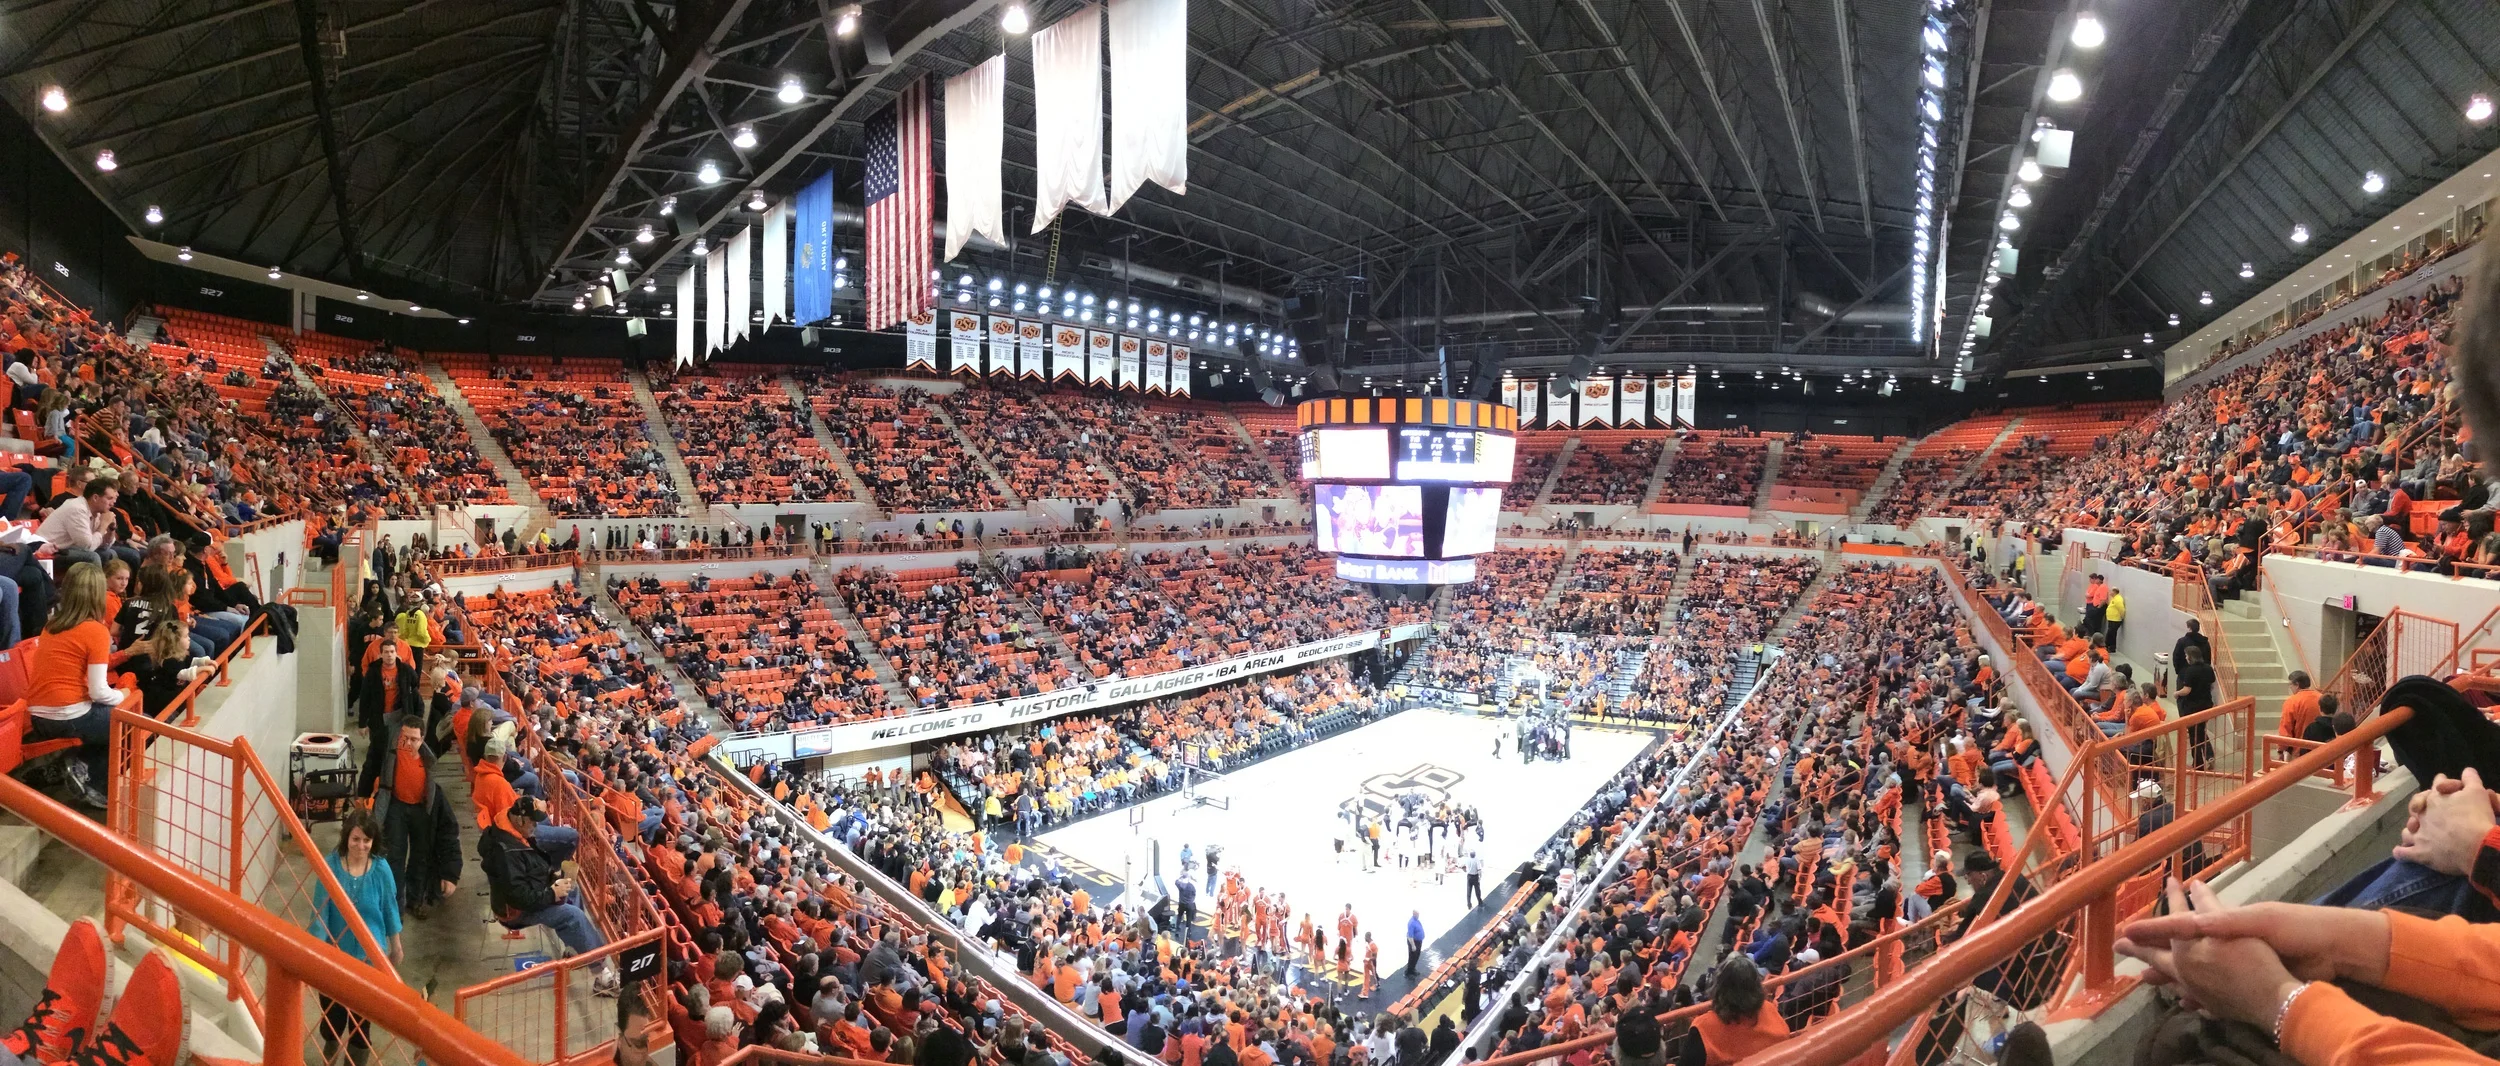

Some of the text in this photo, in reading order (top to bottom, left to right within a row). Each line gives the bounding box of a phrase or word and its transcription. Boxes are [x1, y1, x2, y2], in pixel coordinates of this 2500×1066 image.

[2418, 266, 2436, 281] 318
[200, 287, 223, 298] 327
[1312, 431, 1320, 460] Hertz
[1476, 433, 1484, 463] Hertz
[134, 610, 150, 634] 2
[871, 717, 958, 740] WELCOME
[961, 713, 983, 725] TO
[1010, 690, 1099, 718] HISTORIC
[1243, 654, 1284, 671] ARENA
[1298, 643, 1343, 659] DEDICATED
[630, 953, 655, 972] 217
